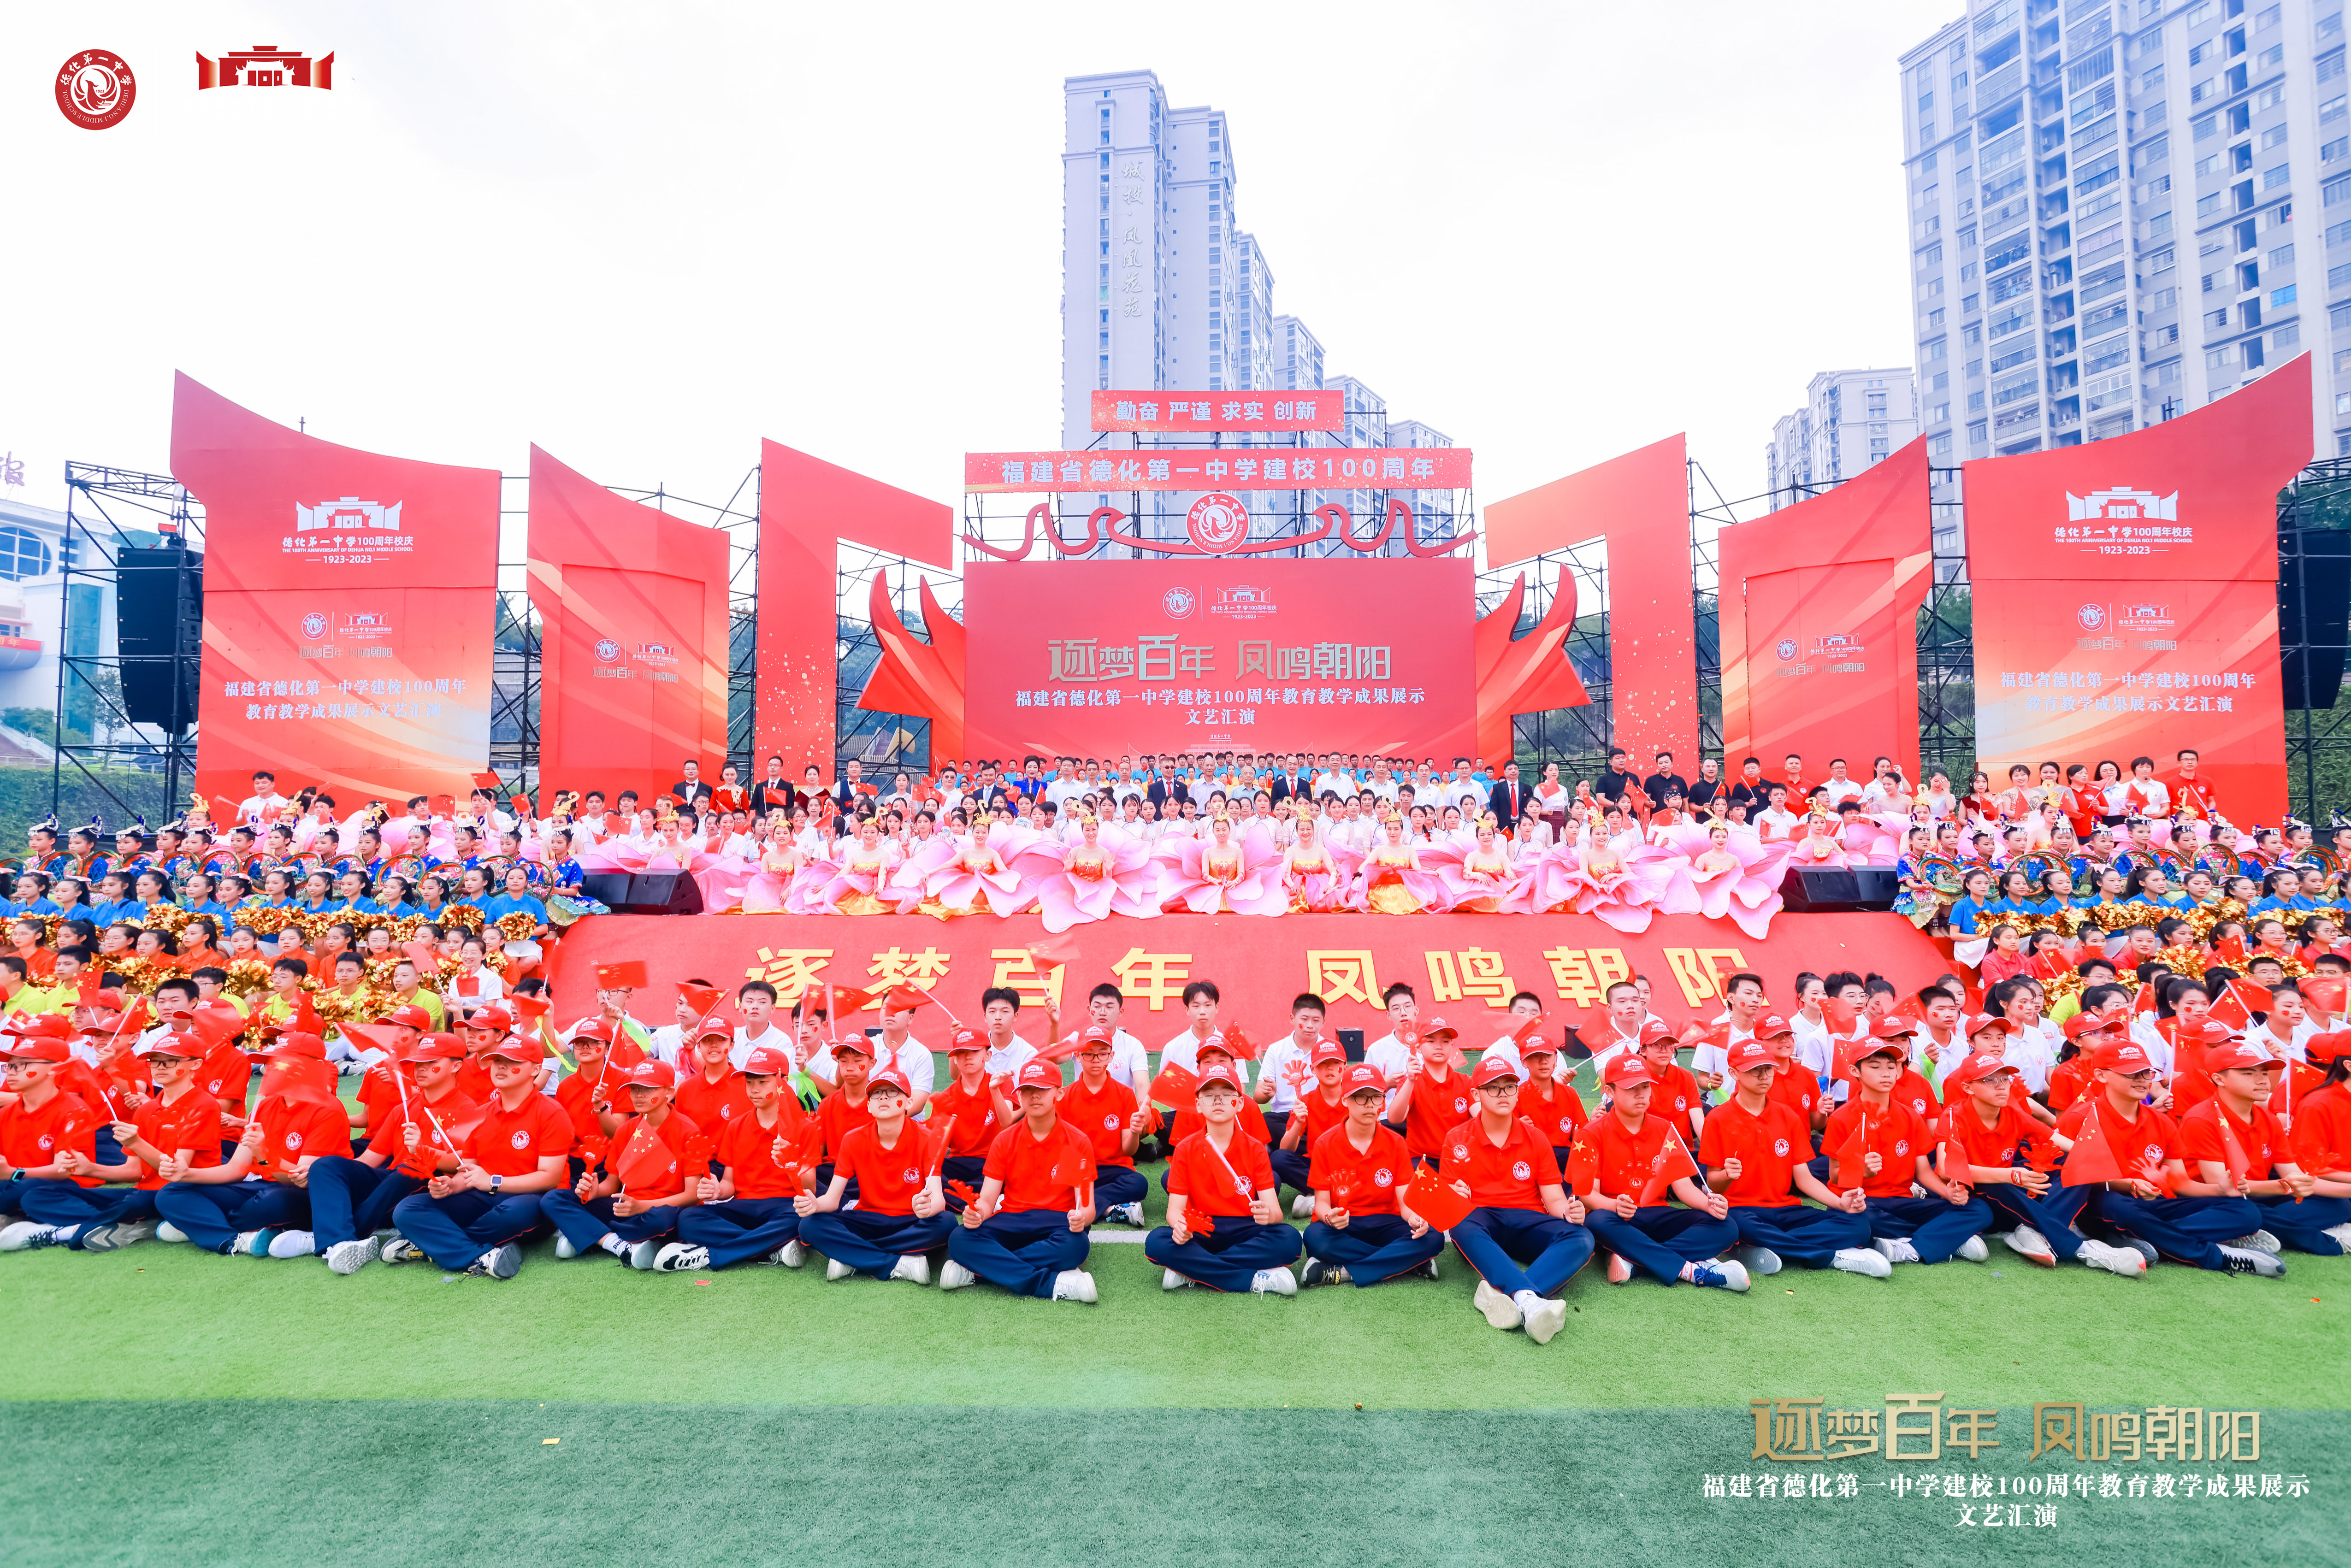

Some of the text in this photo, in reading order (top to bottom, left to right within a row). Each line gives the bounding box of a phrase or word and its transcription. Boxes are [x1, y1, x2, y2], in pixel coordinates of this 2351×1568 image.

[1116, 400, 1317, 422] 勤奋 严谨 求实 创新
[1002, 456, 1435, 483] 福建省德化第一中学建校100周年
[1190, 495, 1246, 522] 德化第一中学
[1192, 523, 1204, 542] SCHOOL
[1234, 524, 1243, 541] DEHUA
[2055, 525, 2193, 538] 德化第一中学100周年校庆
[282, 535, 414, 548] 德化第一中学100周年校庆
[1203, 540, 1223, 548] MIDDLE
[2099, 546, 2150, 554] 1923-2023
[1048, 634, 1391, 682] 逐梦百年 凤鸣朝阳
[224, 679, 467, 697] 福建省德化第一中学建校100周年
[2000, 672, 2256, 688] 福建省德化第一中学建校100周年
[1015, 687, 1425, 707] 福建省德化第一中学建校100周年教育教学成果展示
[2026, 696, 2233, 713] 教育教学成果展示文艺汇演
[246, 702, 442, 720] 教育教学成果展示文艺汇演
[1185, 708, 1256, 725] 文艺汇演
